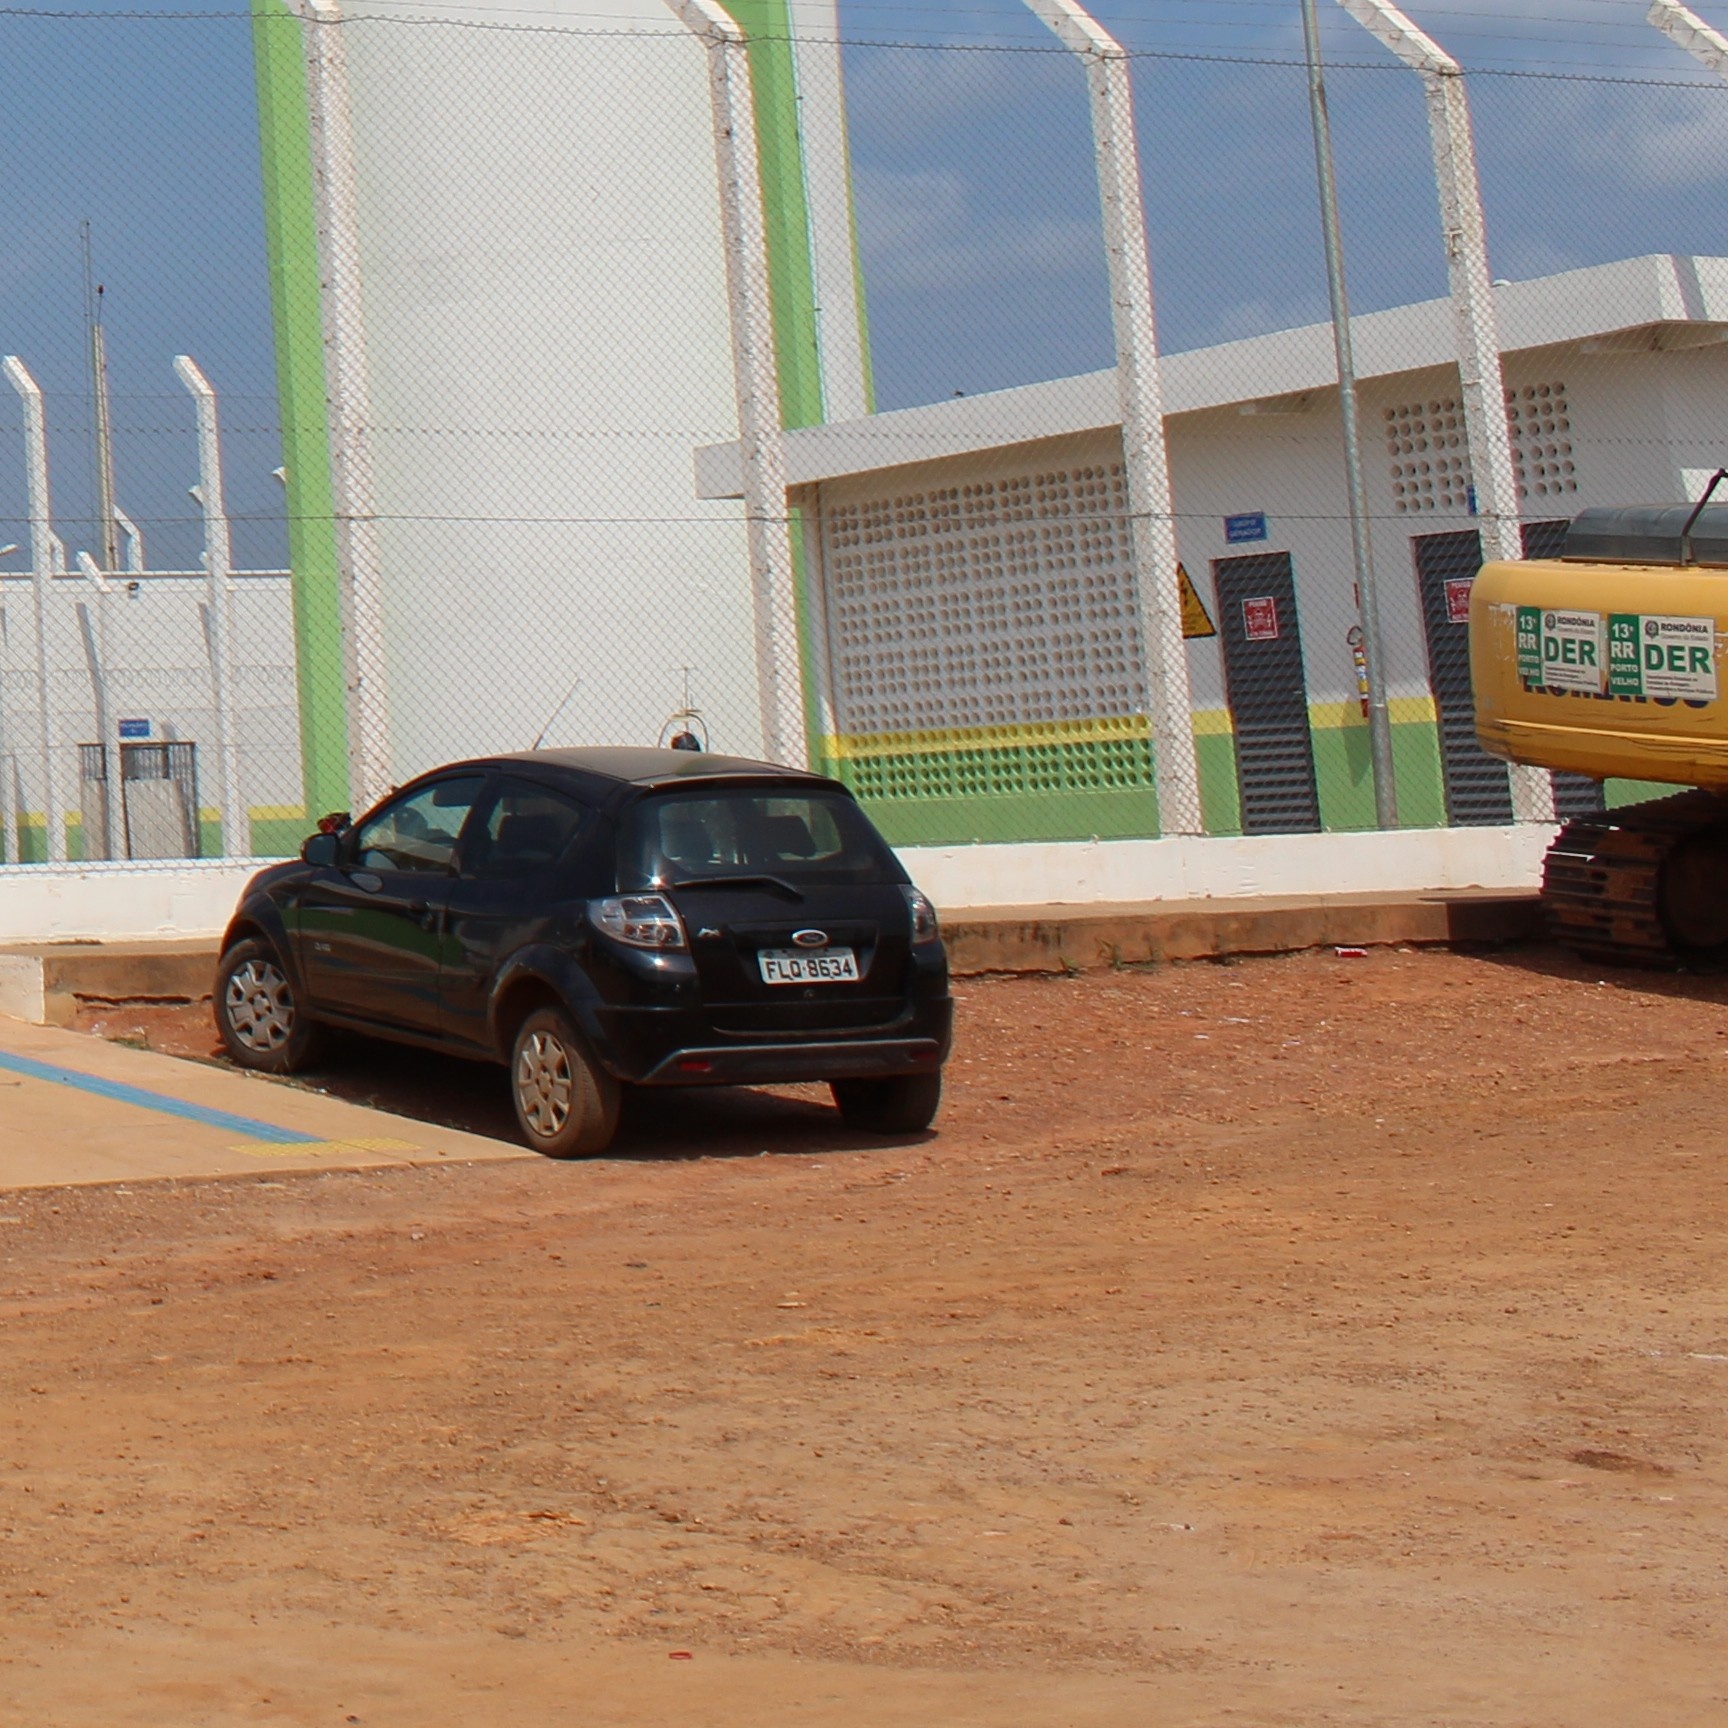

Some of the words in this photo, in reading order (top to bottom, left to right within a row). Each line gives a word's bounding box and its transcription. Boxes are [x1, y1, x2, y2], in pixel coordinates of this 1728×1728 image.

[1557, 616, 1596, 627] RONDÔNIA
[1661, 622, 1709, 634] RONDÔNIA
[1518, 632, 1538, 650] RR
[1545, 636, 1597, 667] DER
[1610, 641, 1636, 659] RR
[1645, 643, 1712, 674] DER
[1610, 663, 1638, 673] PORTO
[1610, 676, 1639, 686] VELHO
